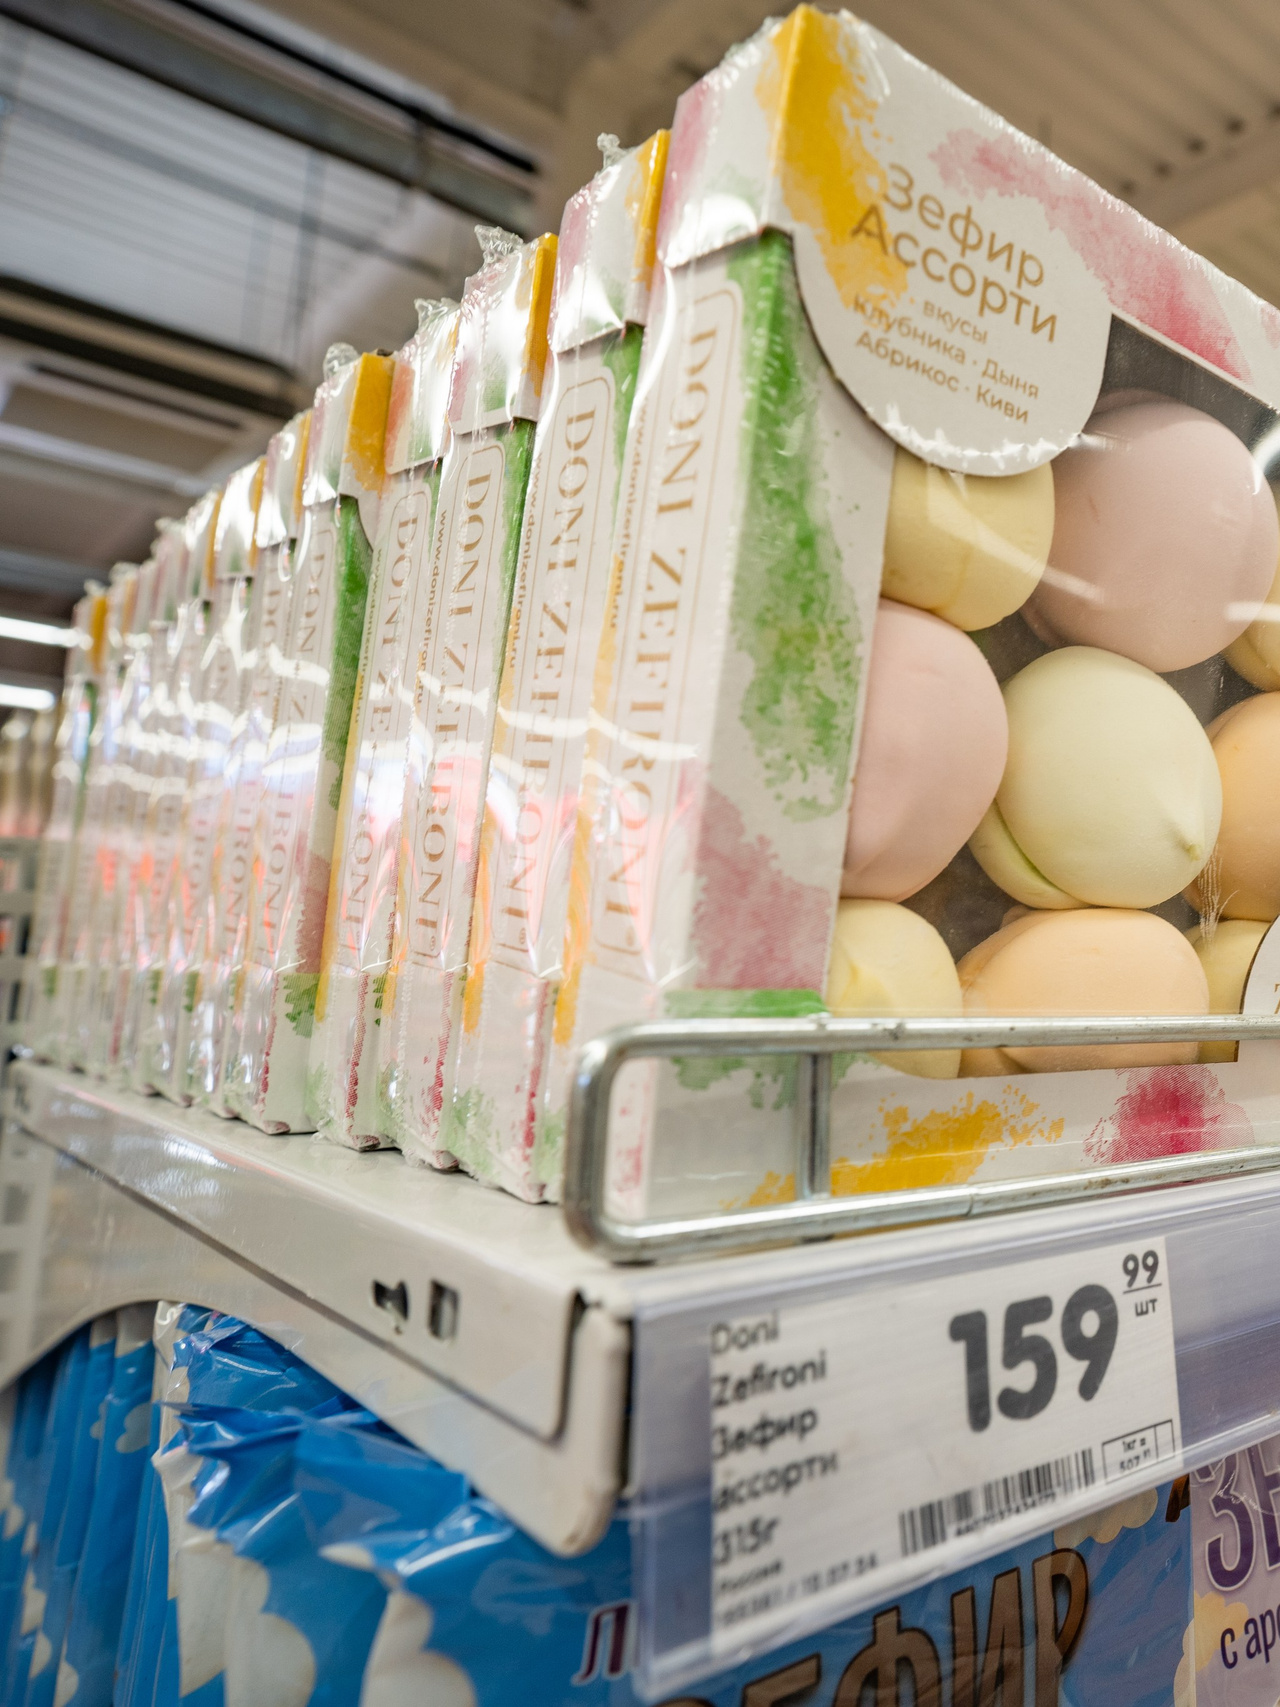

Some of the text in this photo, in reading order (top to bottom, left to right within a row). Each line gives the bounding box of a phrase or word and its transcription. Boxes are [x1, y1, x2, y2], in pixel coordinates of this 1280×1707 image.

[852, 203, 1057, 343] Ассорти
[883, 162, 1044, 289] Зефир
[854, 295, 1039, 400] Клубника Дыня
[923, 300, 988, 344] вкусы
[657, 328, 717, 515] DONI
[856, 330, 1029, 424] Абрикос Киви
[547, 405, 597, 575] DONI
[381, 516, 419, 649] DONI
[450, 469, 492, 617] DONI
[416, 510, 448, 705] www.donizefiron.ru
[1121, 1249, 1160, 1289] 99
[1134, 1297, 1159, 1317] шт
[710, 1312, 781, 1356] Doni
[712, 1350, 828, 1409] Zefironi
[948, 1283, 1120, 1433] 159
[711, 1407, 819, 1461] Зефир
[1220, 1628, 1238, 1670] с
